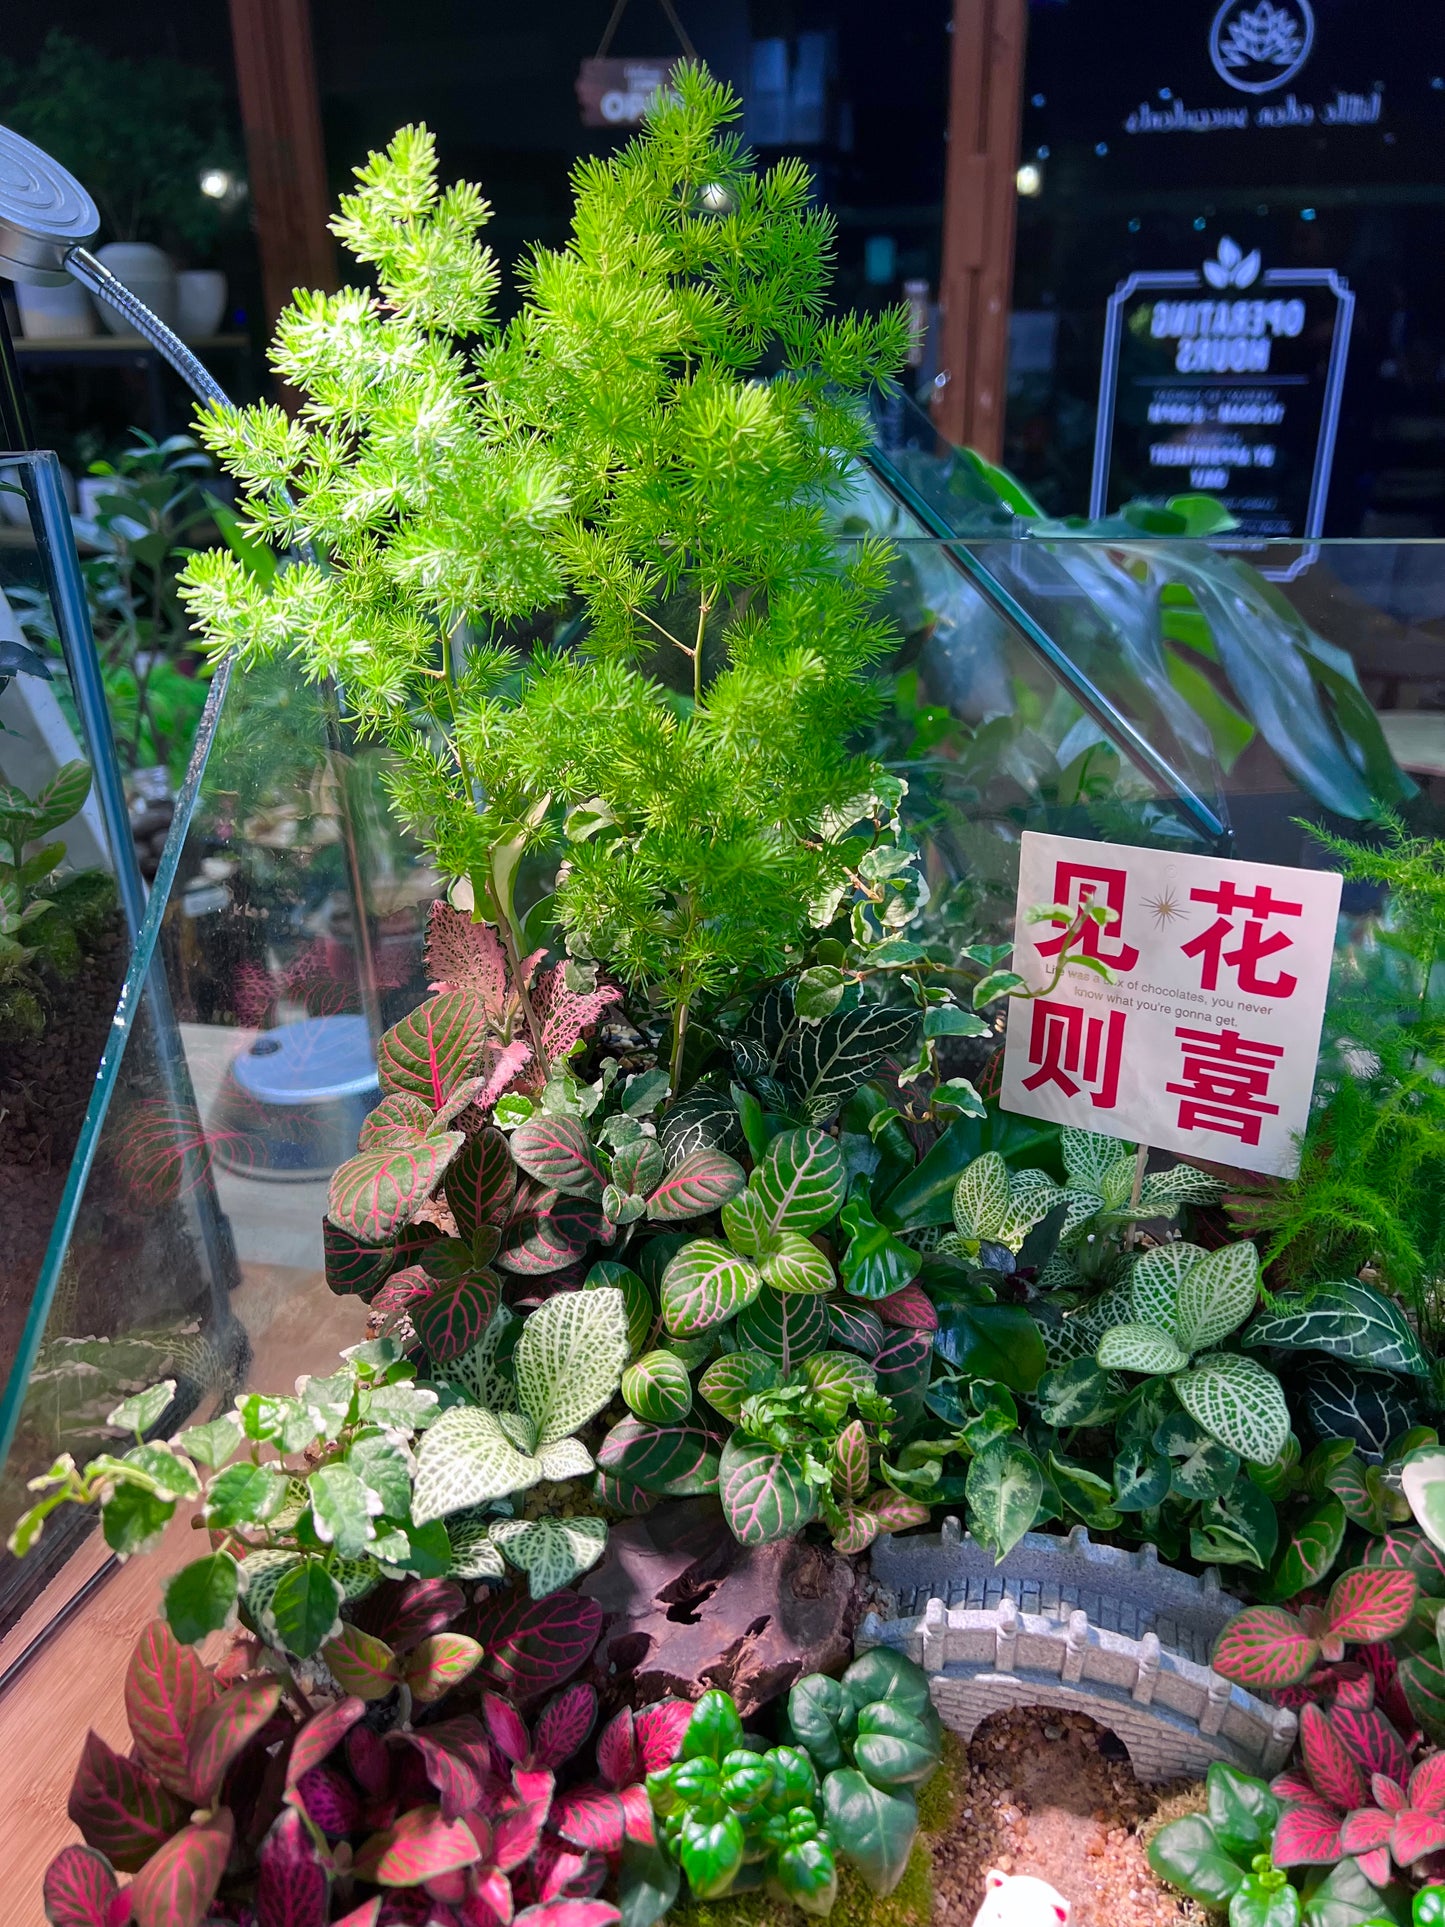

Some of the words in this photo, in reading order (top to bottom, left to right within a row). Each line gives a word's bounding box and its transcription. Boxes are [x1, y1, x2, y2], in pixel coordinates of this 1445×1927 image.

[1045, 963, 1065, 977] Lie
[1068, 969, 1090, 982] was
[1093, 975, 1100, 984] a
[1127, 981, 1138, 990] of
[1141, 983, 1208, 1005] chocolates,
[1211, 997, 1234, 1009] you
[1237, 1002, 1273, 1015] never
[1074, 986, 1104, 1001] know
[1106, 994, 1134, 1007] what
[1136, 1000, 1172, 1014] you're
[1175, 1007, 1212, 1022] gonna
[1215, 1015, 1238, 1027] get.
